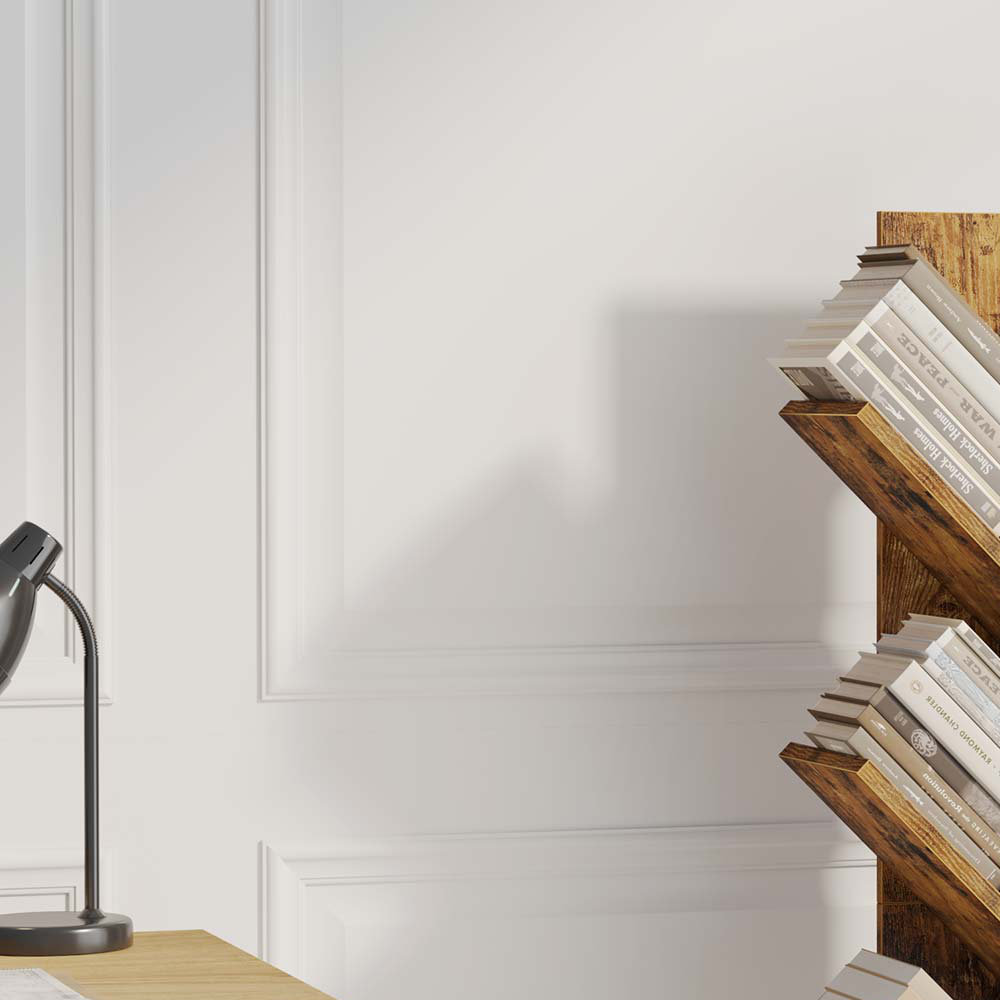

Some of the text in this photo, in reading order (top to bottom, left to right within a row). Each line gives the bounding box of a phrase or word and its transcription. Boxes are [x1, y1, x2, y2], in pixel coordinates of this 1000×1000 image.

[895, 332, 950, 388] PEACE
[929, 406, 994, 475] Sherlock Holmes
[957, 397, 998, 441] WAR
[909, 426, 975, 495] Sherlock Holmes
